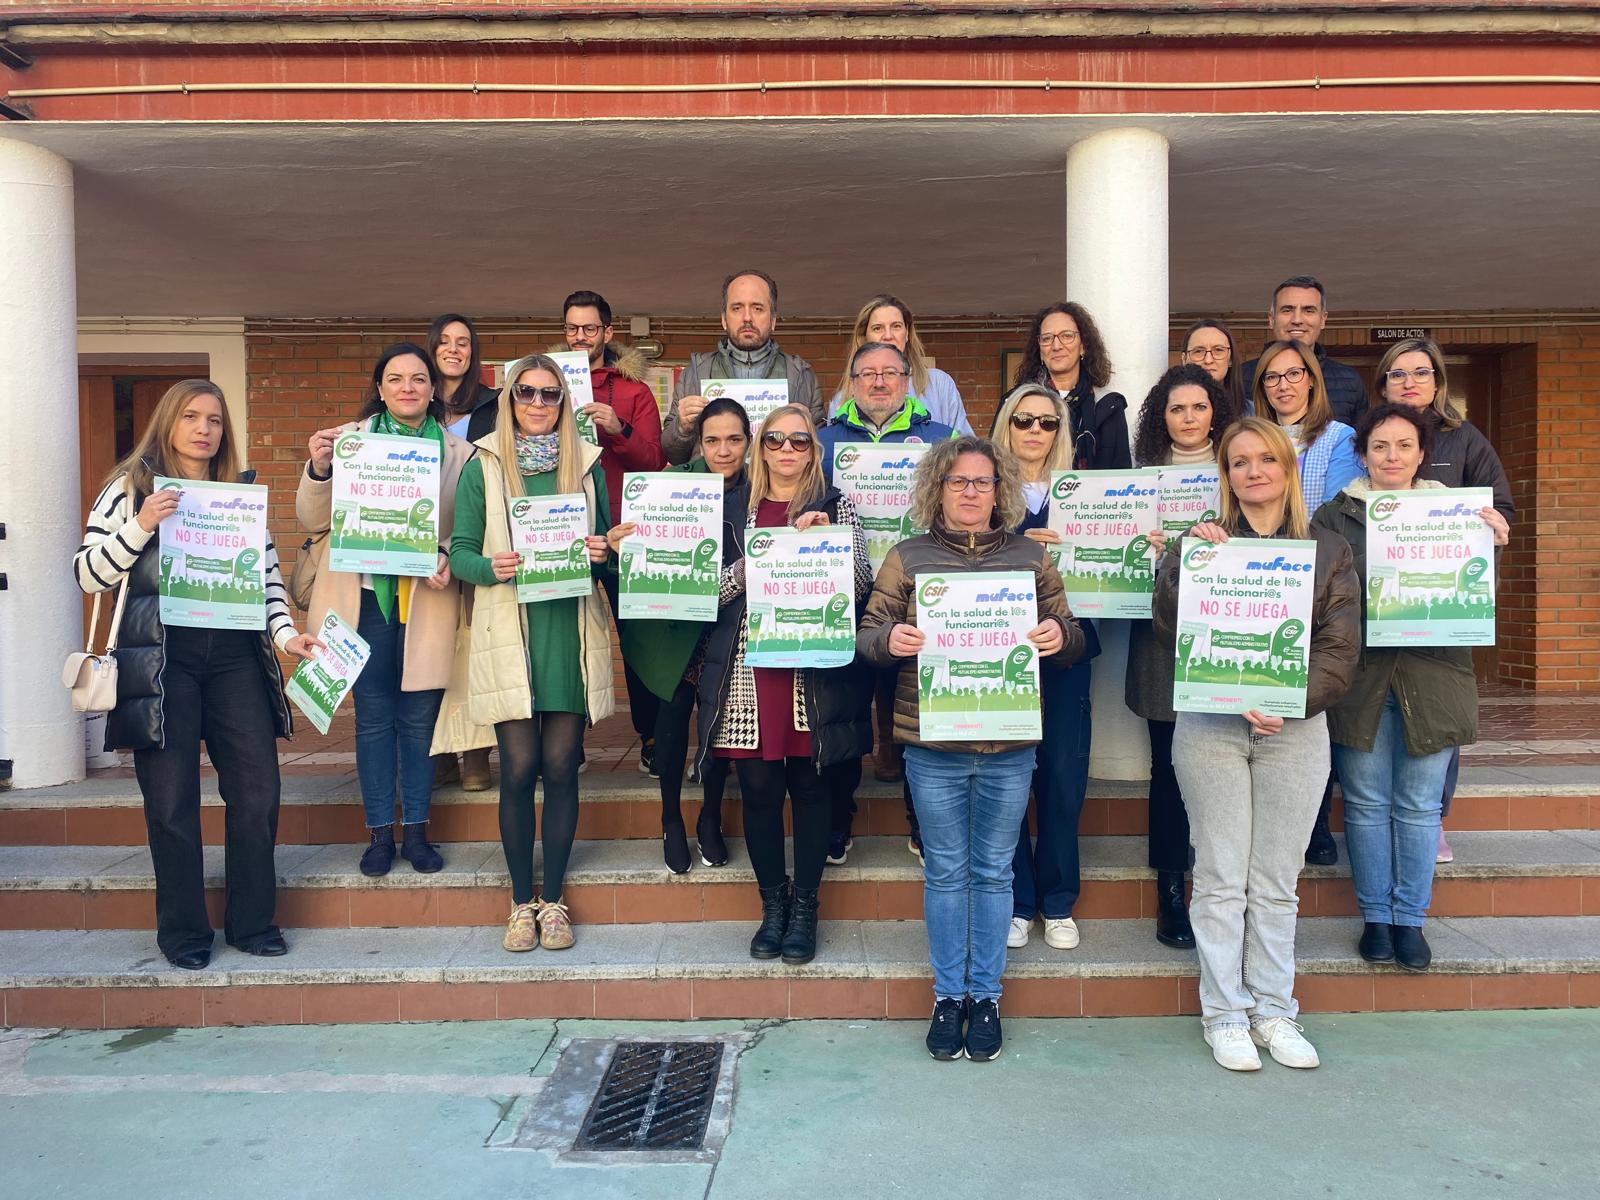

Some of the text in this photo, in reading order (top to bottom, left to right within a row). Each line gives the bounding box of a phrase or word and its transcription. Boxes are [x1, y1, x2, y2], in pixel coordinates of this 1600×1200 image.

[1378, 330, 1396, 338] SALON
[1406, 329, 1424, 337] ACTOS
[562, 364, 588, 374] face
[745, 391, 787, 400] muface
[387, 451, 438, 463] muface
[358, 472, 415, 483] funcionari@s
[1181, 475, 1218, 483] muface
[351, 483, 422, 498] NO SE JUEGA
[671, 488, 721, 500] muface
[1104, 484, 1156, 496] muface
[210, 498, 264, 510] muface
[867, 494, 878, 505] SE
[549, 505, 585, 513] muface
[629, 503, 645, 511] Con
[1060, 502, 1077, 510] Con
[1081, 502, 1089, 510] la
[1170, 503, 1179, 512] SE
[1182, 502, 1207, 511] JUEGA
[1428, 504, 1481, 517] mufac
[188, 510, 195, 518] la
[199, 513, 224, 521] salud
[227, 514, 239, 522] de
[643, 514, 698, 522] funcionari@s
[1074, 512, 1133, 520] funcionari@s
[182, 519, 240, 532] funcionari@s
[530, 523, 570, 531] funcionari@s
[1066, 523, 1139, 536] NO SE JUEGA
[1378, 524, 1397, 532] Con
[1402, 523, 1411, 531] la
[1415, 523, 1444, 531] salud
[1448, 522, 1462, 530] de
[525, 531, 576, 543] NO SE JUEGA
[636, 525, 705, 538] NO SE JUEGA
[176, 530, 247, 548] NO SE JUEGA
[1395, 533, 1463, 542] funcionari@s
[799, 541, 851, 554] muface
[1387, 545, 1472, 559] NO SE JUEGA
[776, 560, 784, 568] la
[788, 559, 812, 567] salud
[816, 559, 827, 567] de
[1246, 557, 1312, 571] muface
[771, 569, 828, 578] funcionari@s
[1192, 575, 1213, 583] Con
[1217, 575, 1227, 583] la
[1232, 576, 1262, 585] salud
[1266, 577, 1280, 586] de
[764, 581, 836, 595] NO SE JUEGA
[1210, 587, 1281, 598] funcionari@s
[976, 588, 1033, 602] muface
[928, 610, 947, 618] Con
[951, 609, 960, 618] la
[964, 609, 991, 617] salud
[995, 608, 1008, 616] de
[1200, 601, 1288, 618] NO SE JUEGA
[946, 619, 1010, 629] funcionari@s
[938, 632, 1018, 647] NO SE JUEGA
